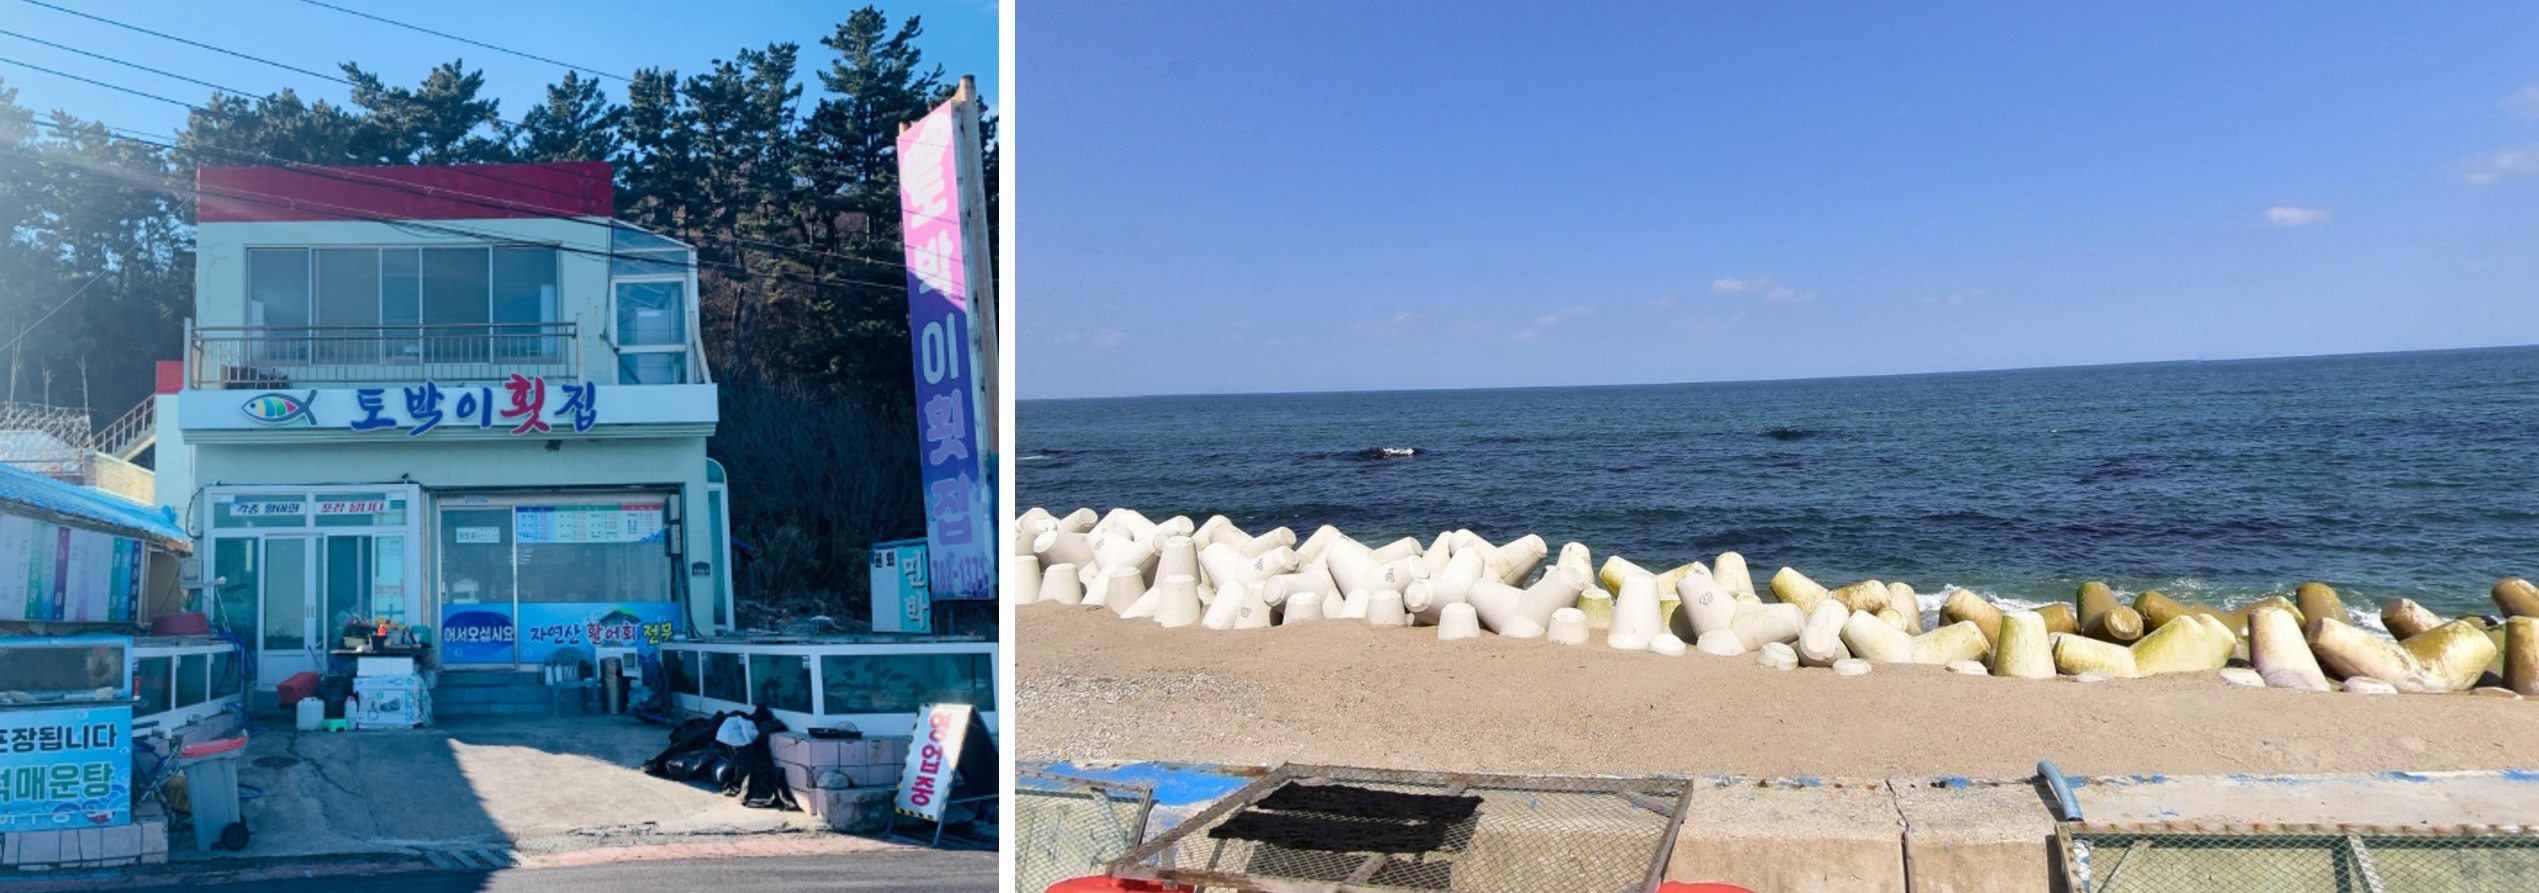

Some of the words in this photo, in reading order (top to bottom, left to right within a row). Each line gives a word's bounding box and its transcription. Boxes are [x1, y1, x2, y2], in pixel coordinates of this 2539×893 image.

[350, 373, 597, 437] 토박이횟집
[903, 550, 929, 629] 민박
[530, 624, 580, 644] 자연산
[587, 622, 636, 645] 활어회
[910, 712, 952, 807] 영업중
